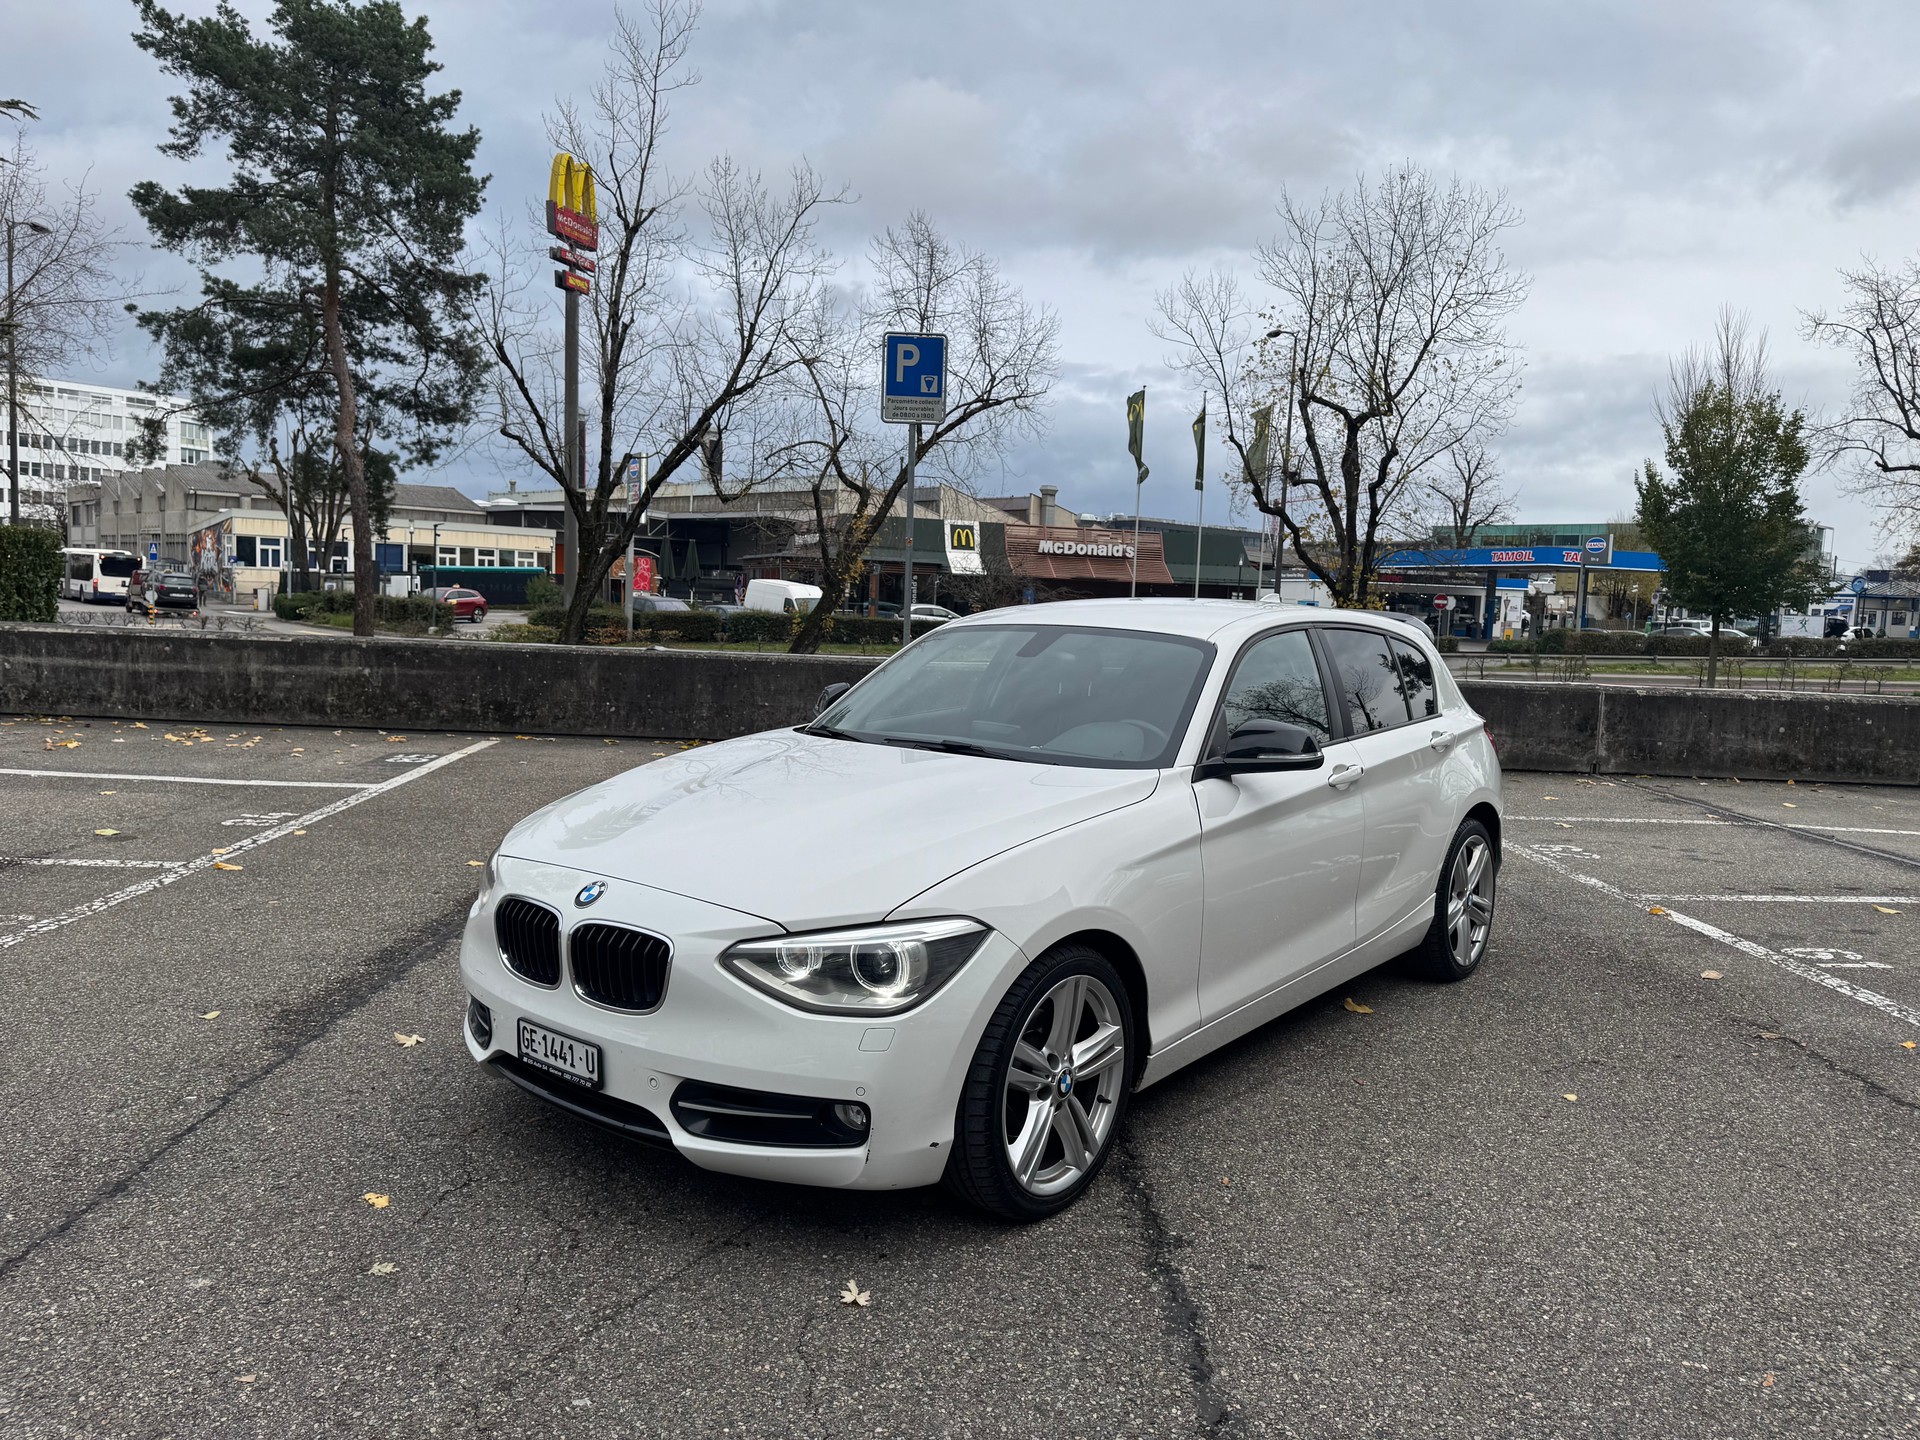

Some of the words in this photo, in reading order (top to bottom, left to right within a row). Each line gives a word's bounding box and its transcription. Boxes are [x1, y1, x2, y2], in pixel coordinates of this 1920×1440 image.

[896, 343, 920, 382] P
[1038, 540, 1135, 558] McDonald's
[1491, 550, 1535, 562] TAMOIL
